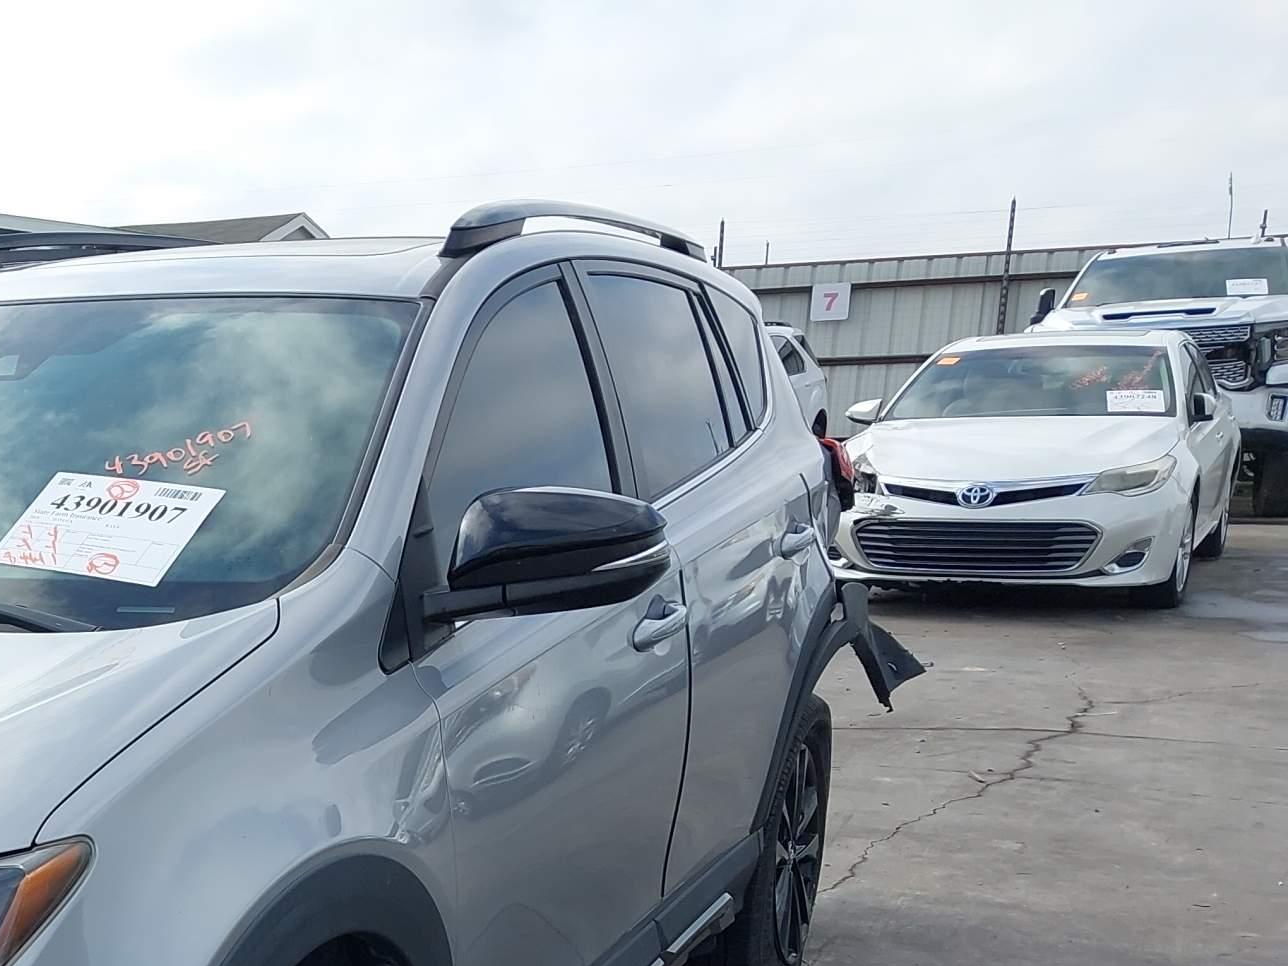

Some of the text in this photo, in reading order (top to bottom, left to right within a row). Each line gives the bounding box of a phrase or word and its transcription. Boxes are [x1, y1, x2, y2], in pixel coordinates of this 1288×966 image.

[823, 292, 839, 311] 7
[104, 421, 251, 476] 43901907
[50, 493, 188, 524] 43901907
